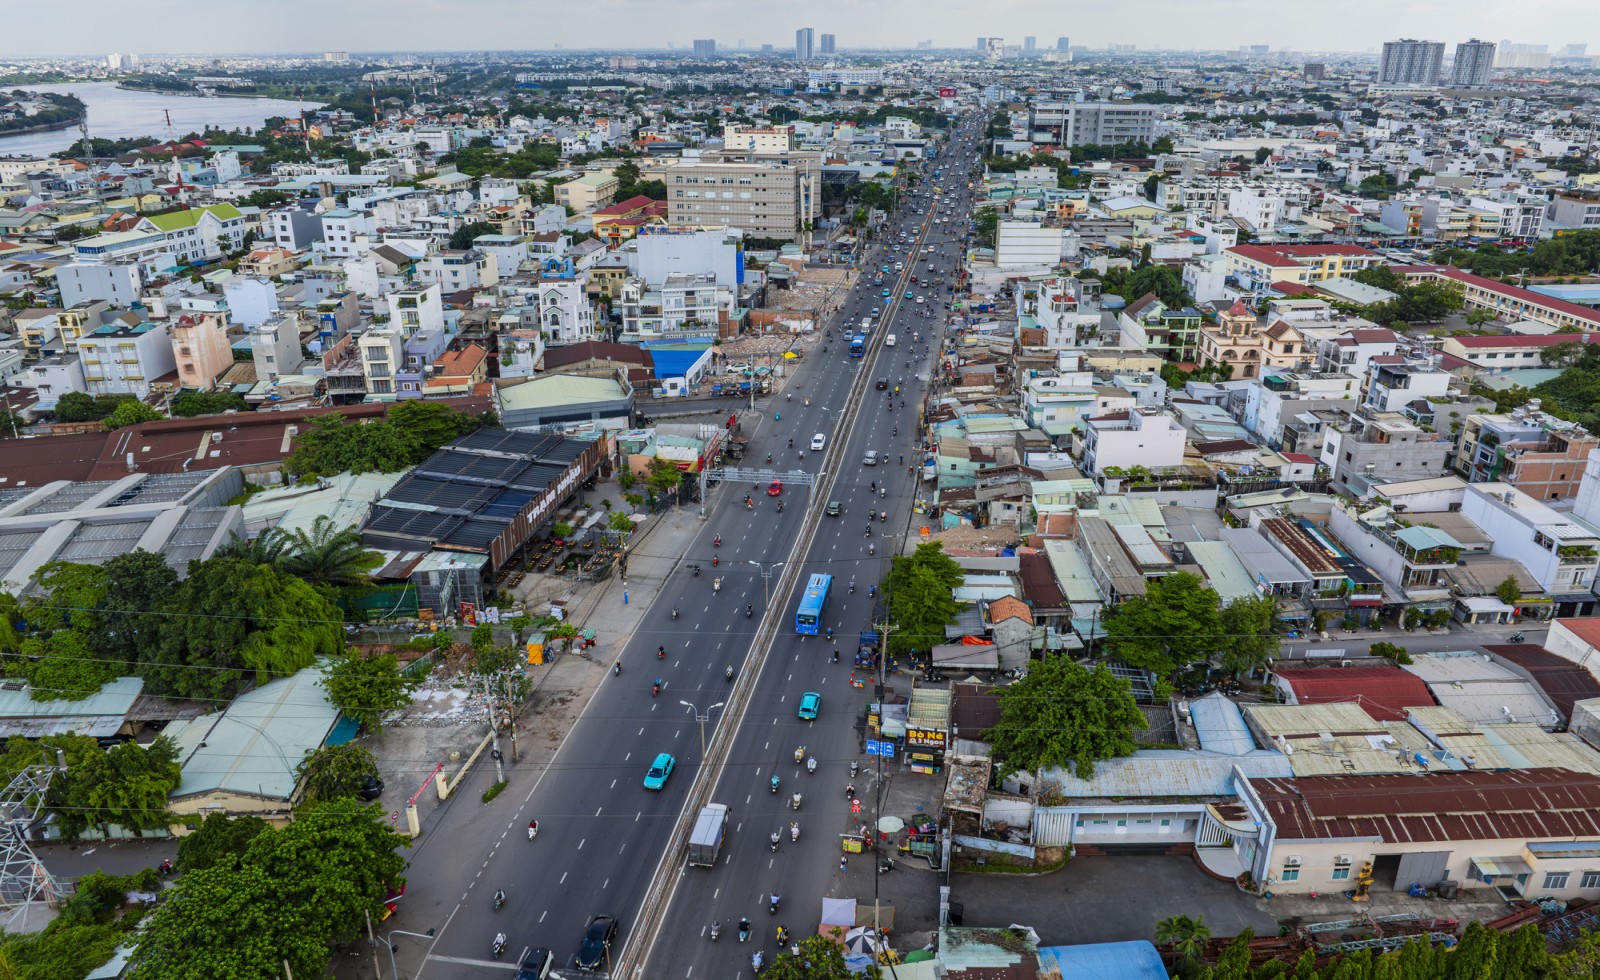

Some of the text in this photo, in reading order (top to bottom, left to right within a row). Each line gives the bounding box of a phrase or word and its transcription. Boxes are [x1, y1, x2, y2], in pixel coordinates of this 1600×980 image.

[909, 730, 943, 739] Bò Né
[923, 738, 944, 746] Ngon
